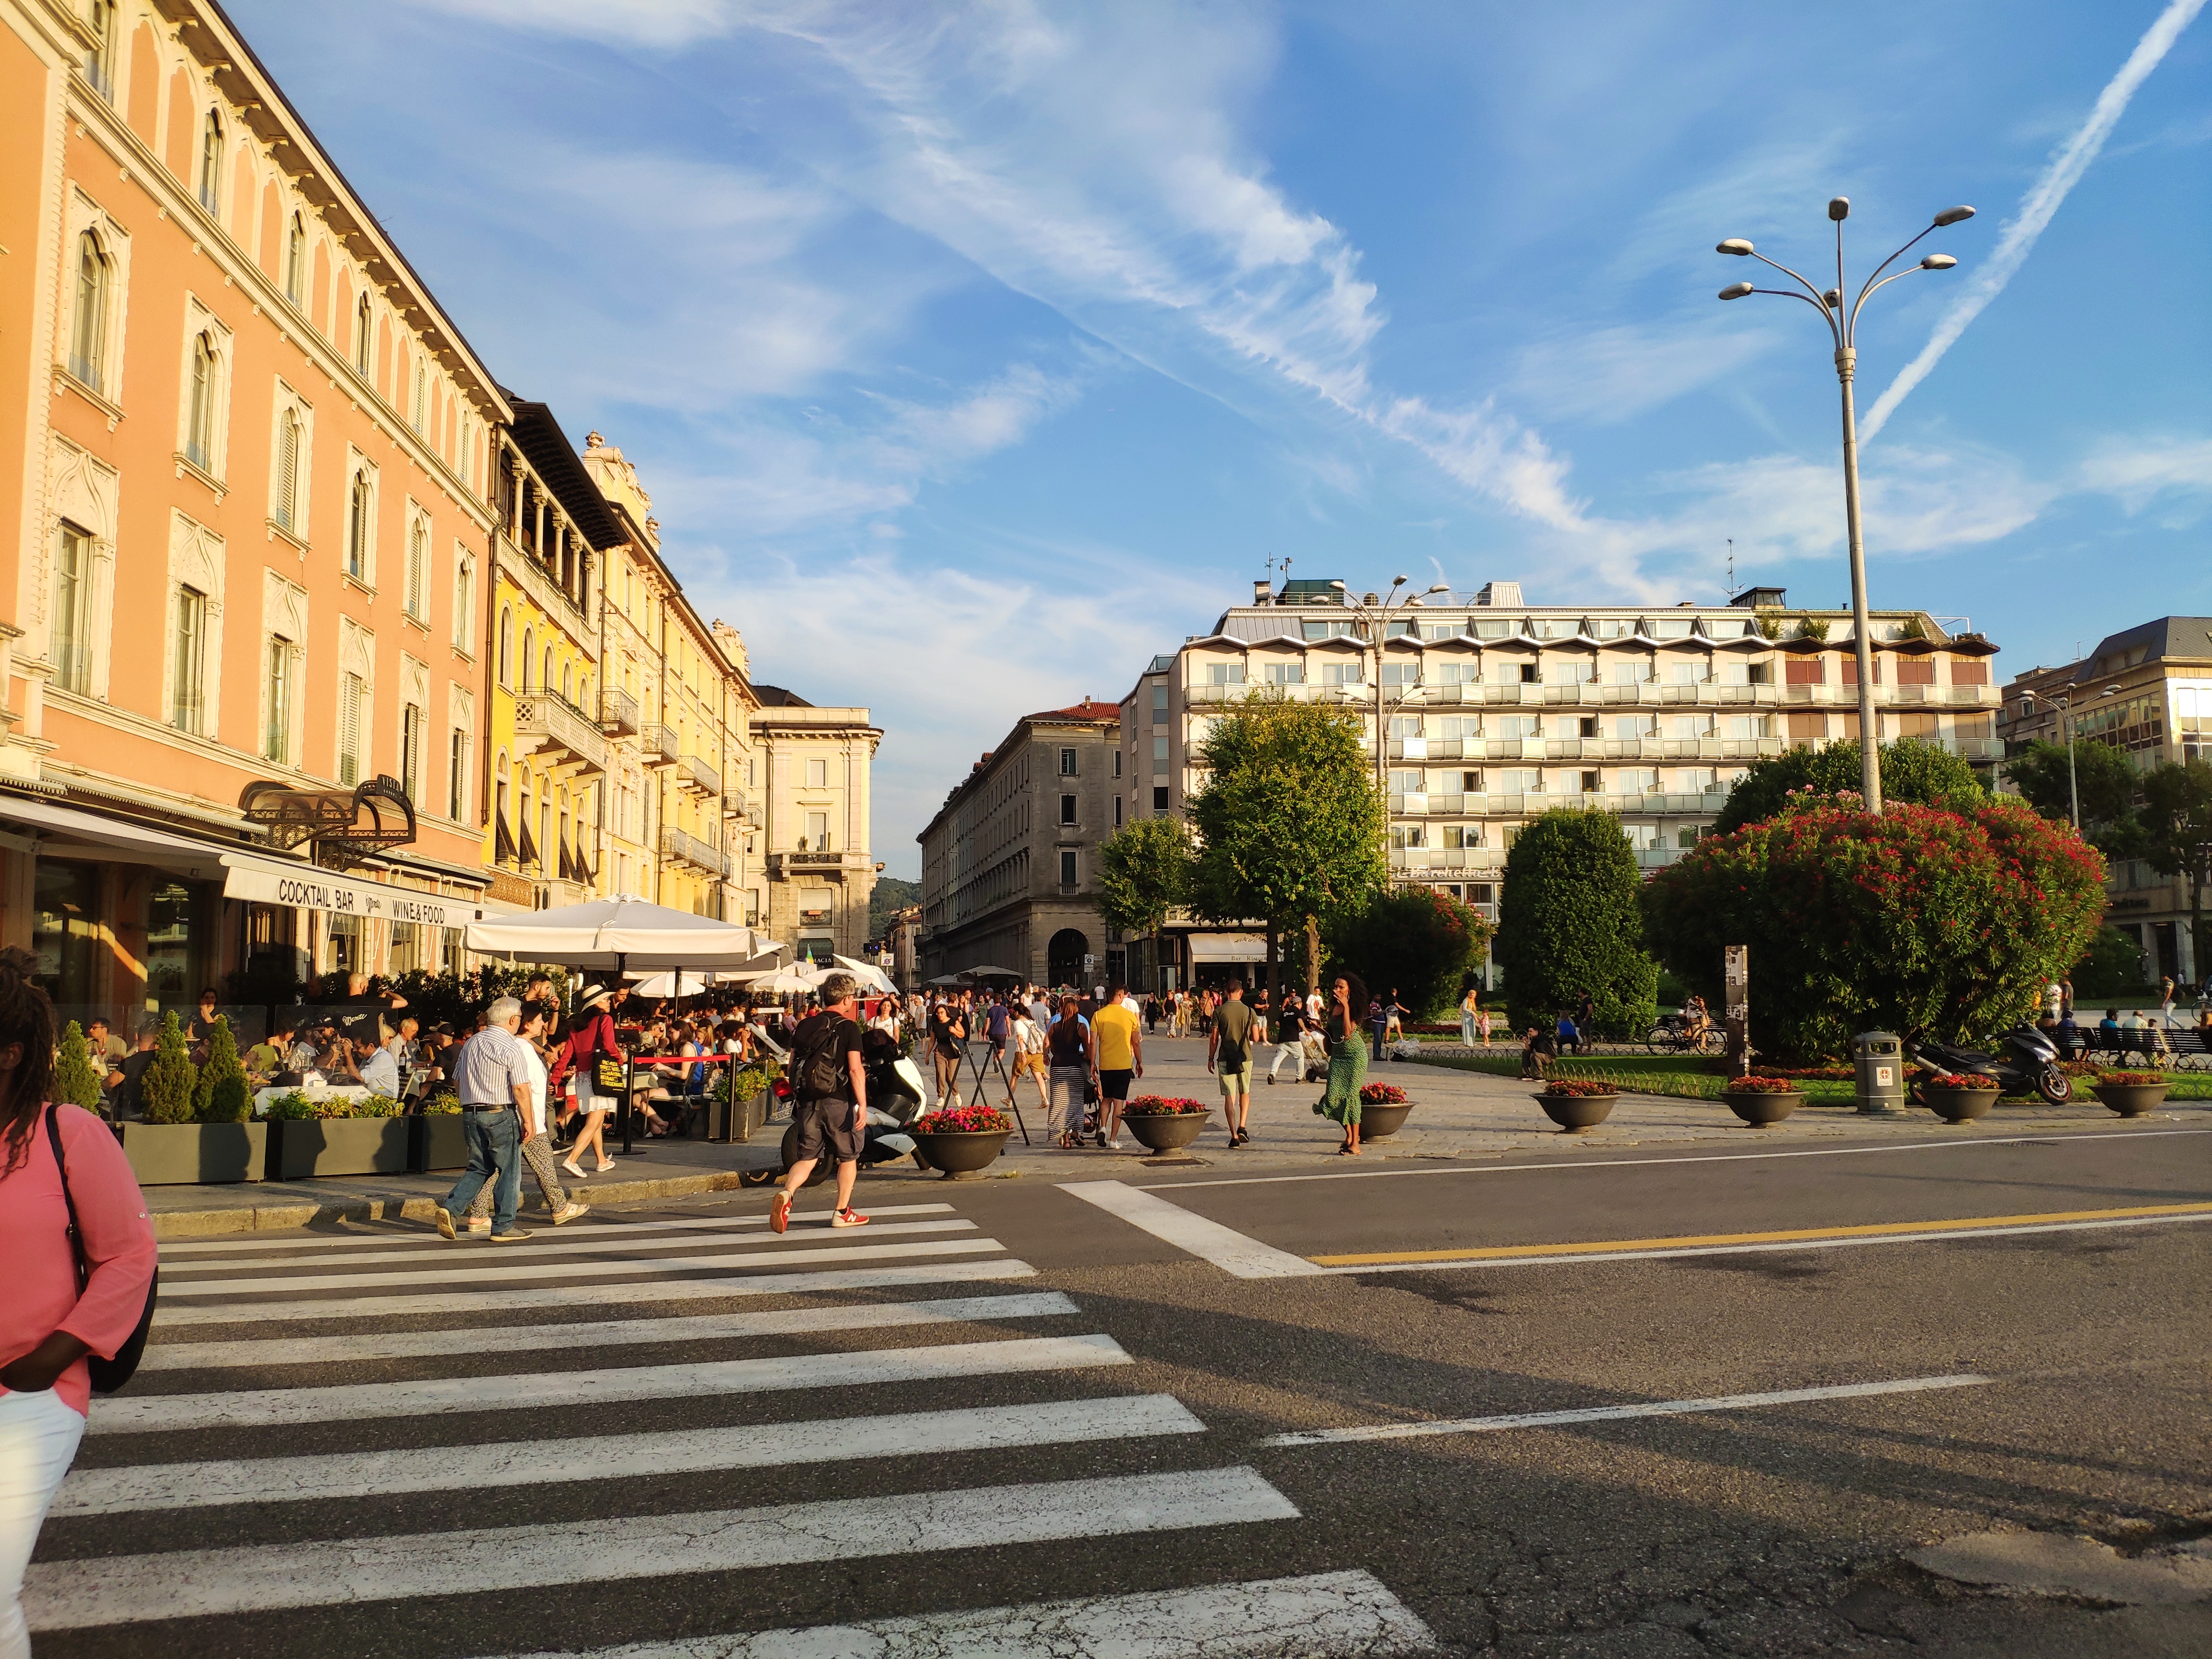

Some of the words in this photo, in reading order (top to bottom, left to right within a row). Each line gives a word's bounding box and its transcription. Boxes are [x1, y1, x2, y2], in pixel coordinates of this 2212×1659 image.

[279, 879, 331, 907] COCKTAIL
[336, 889, 354, 911] BAR
[392, 899, 416, 919] WINE
[423, 905, 445, 924] FOOD
